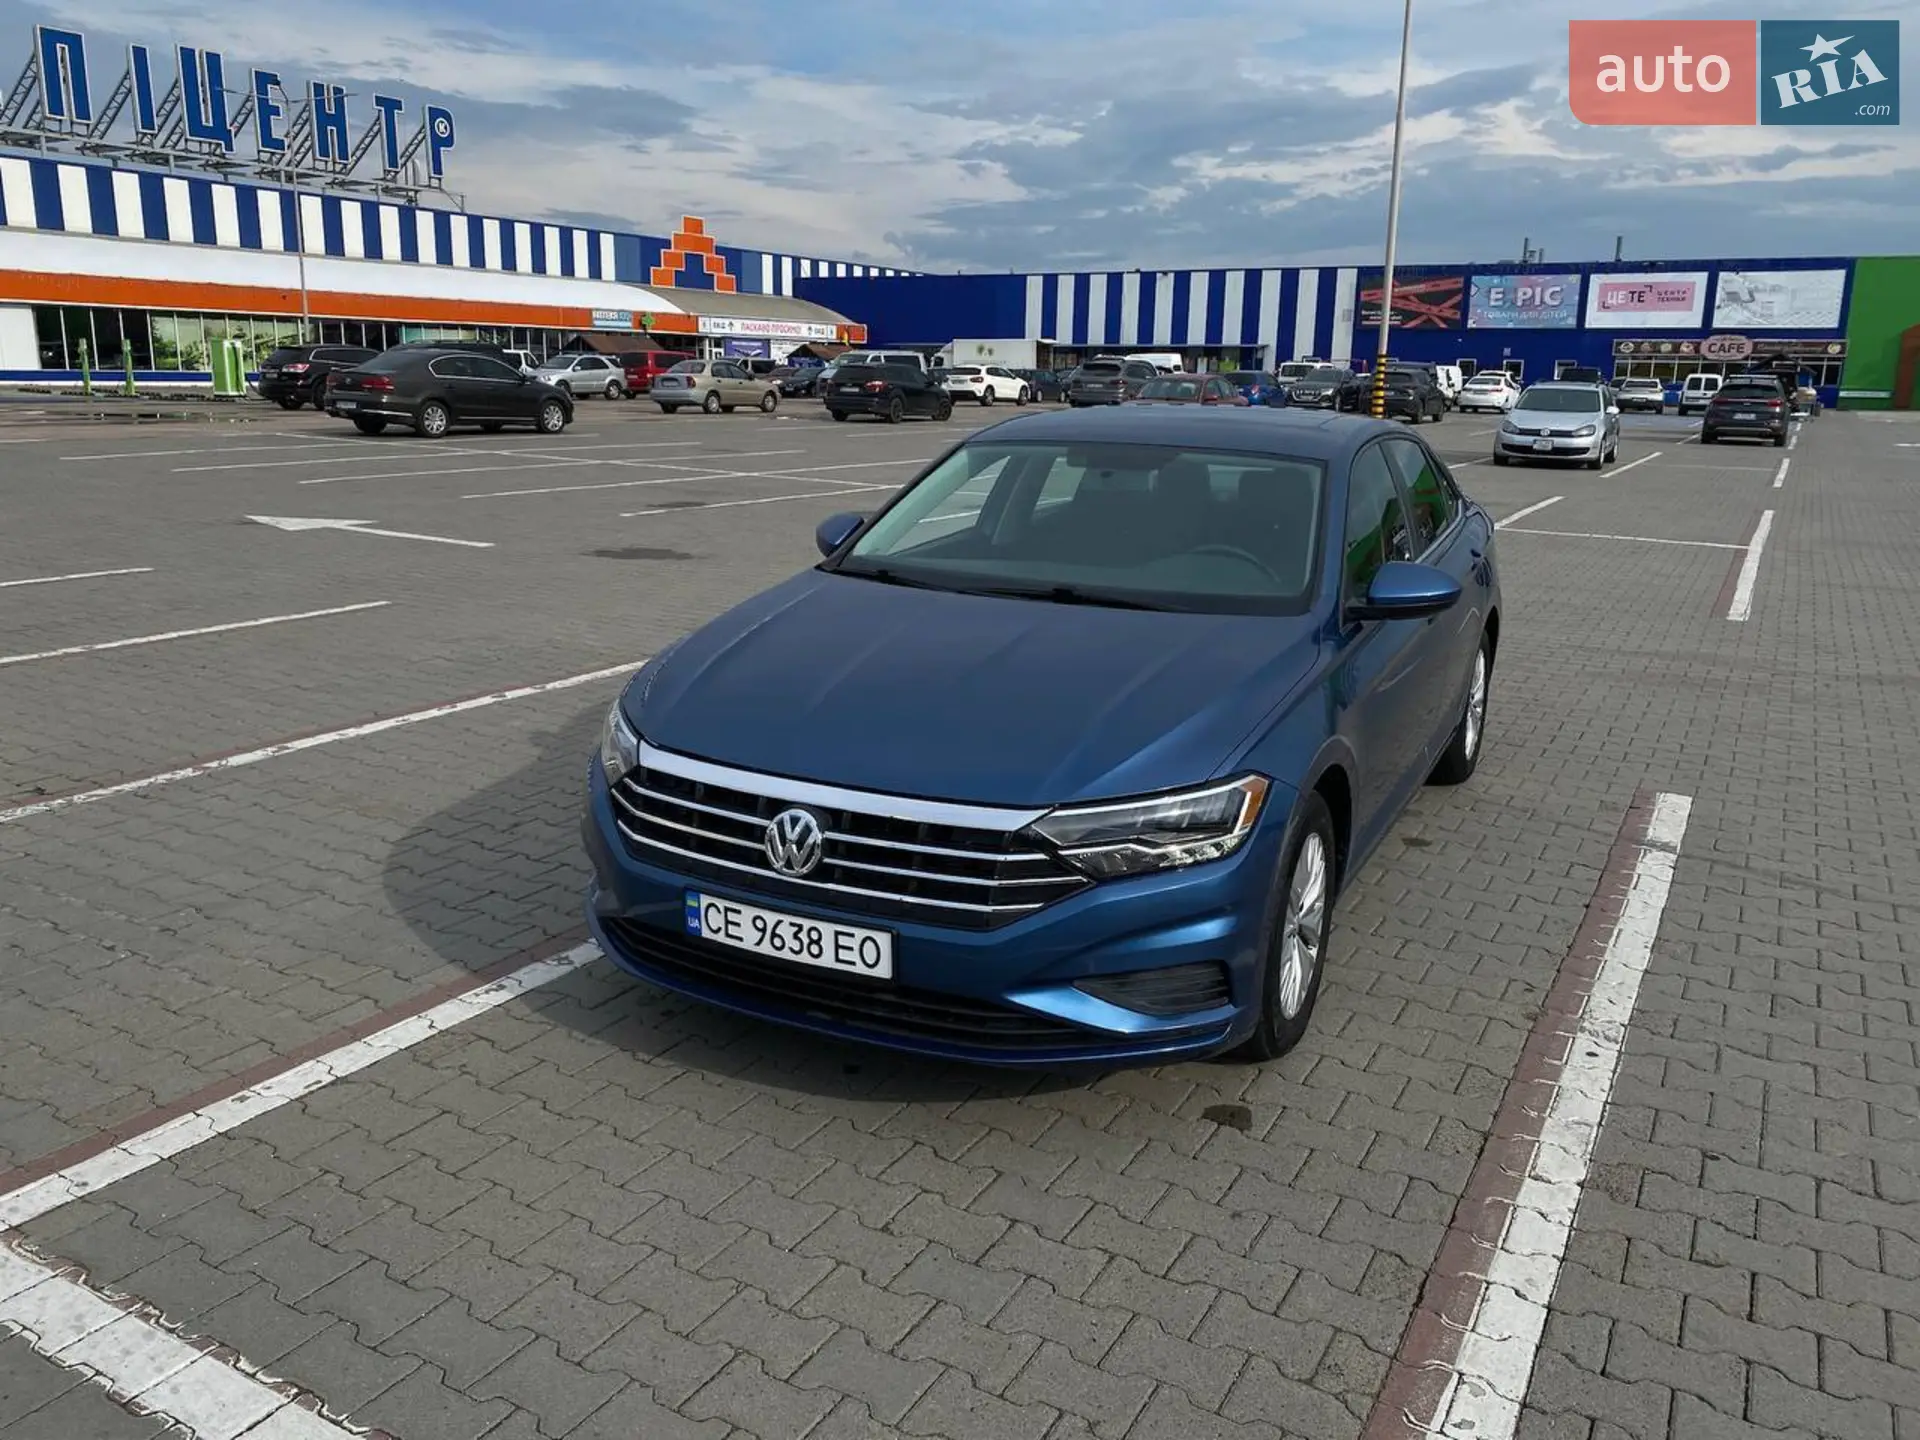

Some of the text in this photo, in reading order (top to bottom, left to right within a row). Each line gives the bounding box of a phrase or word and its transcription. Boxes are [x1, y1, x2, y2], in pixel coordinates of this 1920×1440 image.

[0, 24, 456, 179] ПІЦЕНТР
[1607, 290, 1646, 305] ЦЕТЕ
[1707, 341, 1746, 354] CAFE
[704, 902, 881, 969] CE 9638 EO
